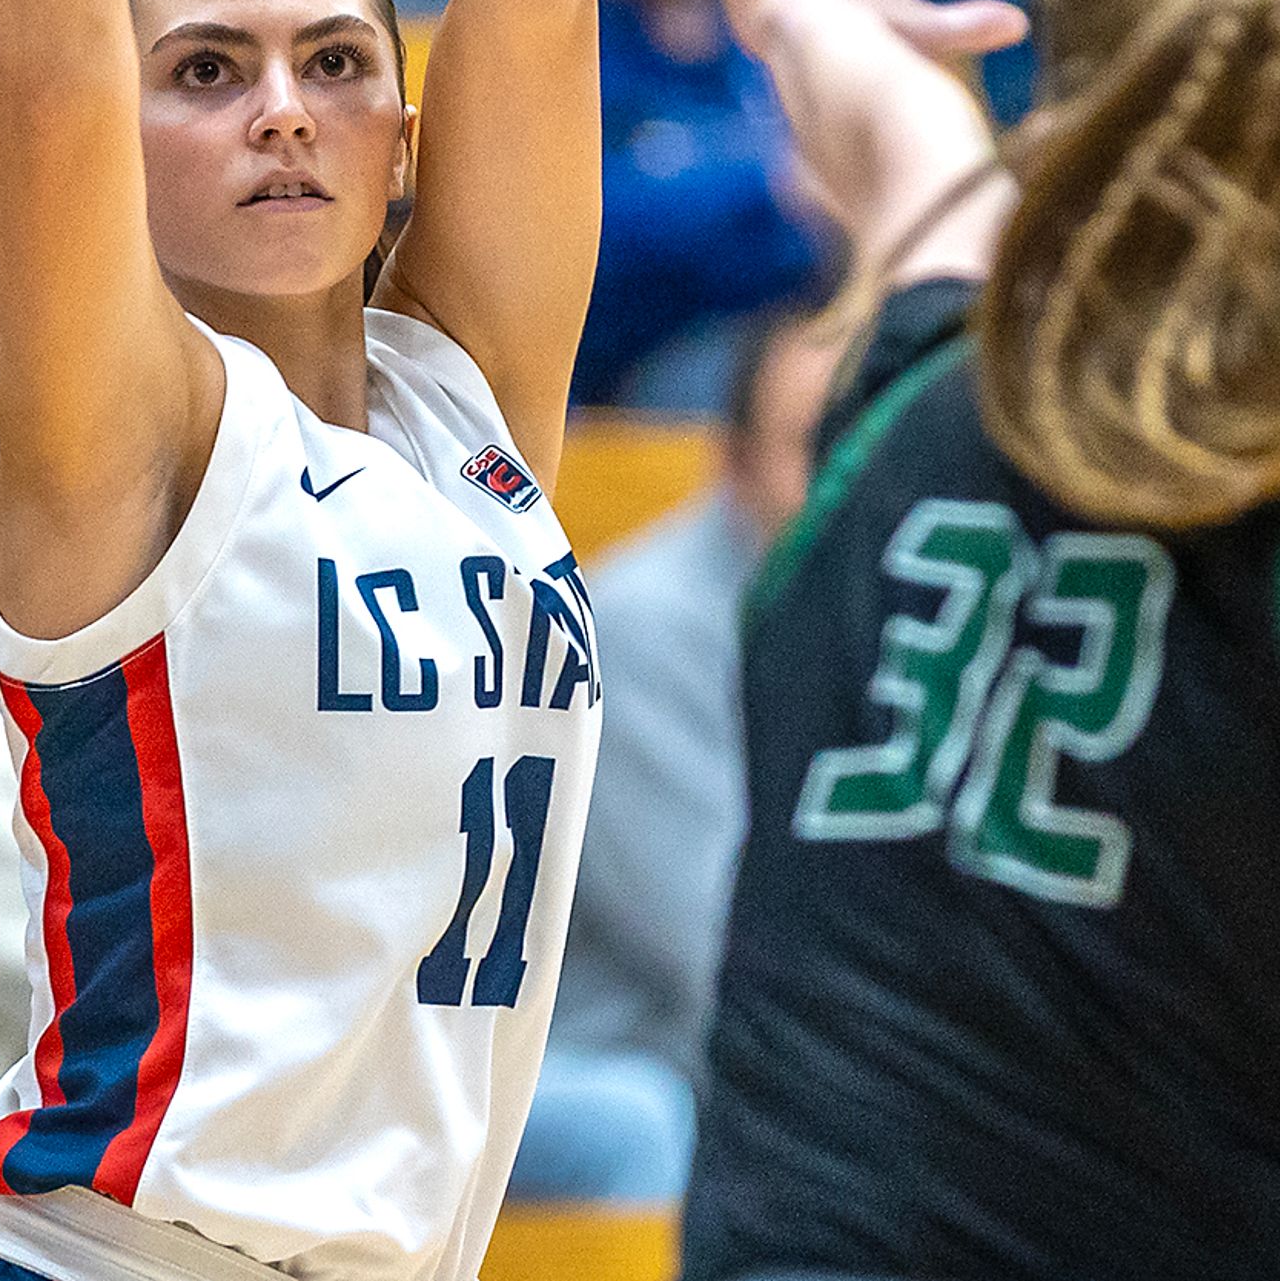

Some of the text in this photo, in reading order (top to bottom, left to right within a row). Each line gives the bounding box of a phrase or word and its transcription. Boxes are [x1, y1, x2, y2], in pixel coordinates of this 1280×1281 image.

[317, 556, 439, 712] LC
[792, 498, 1177, 909] 32
[417, 754, 556, 1009] 11
